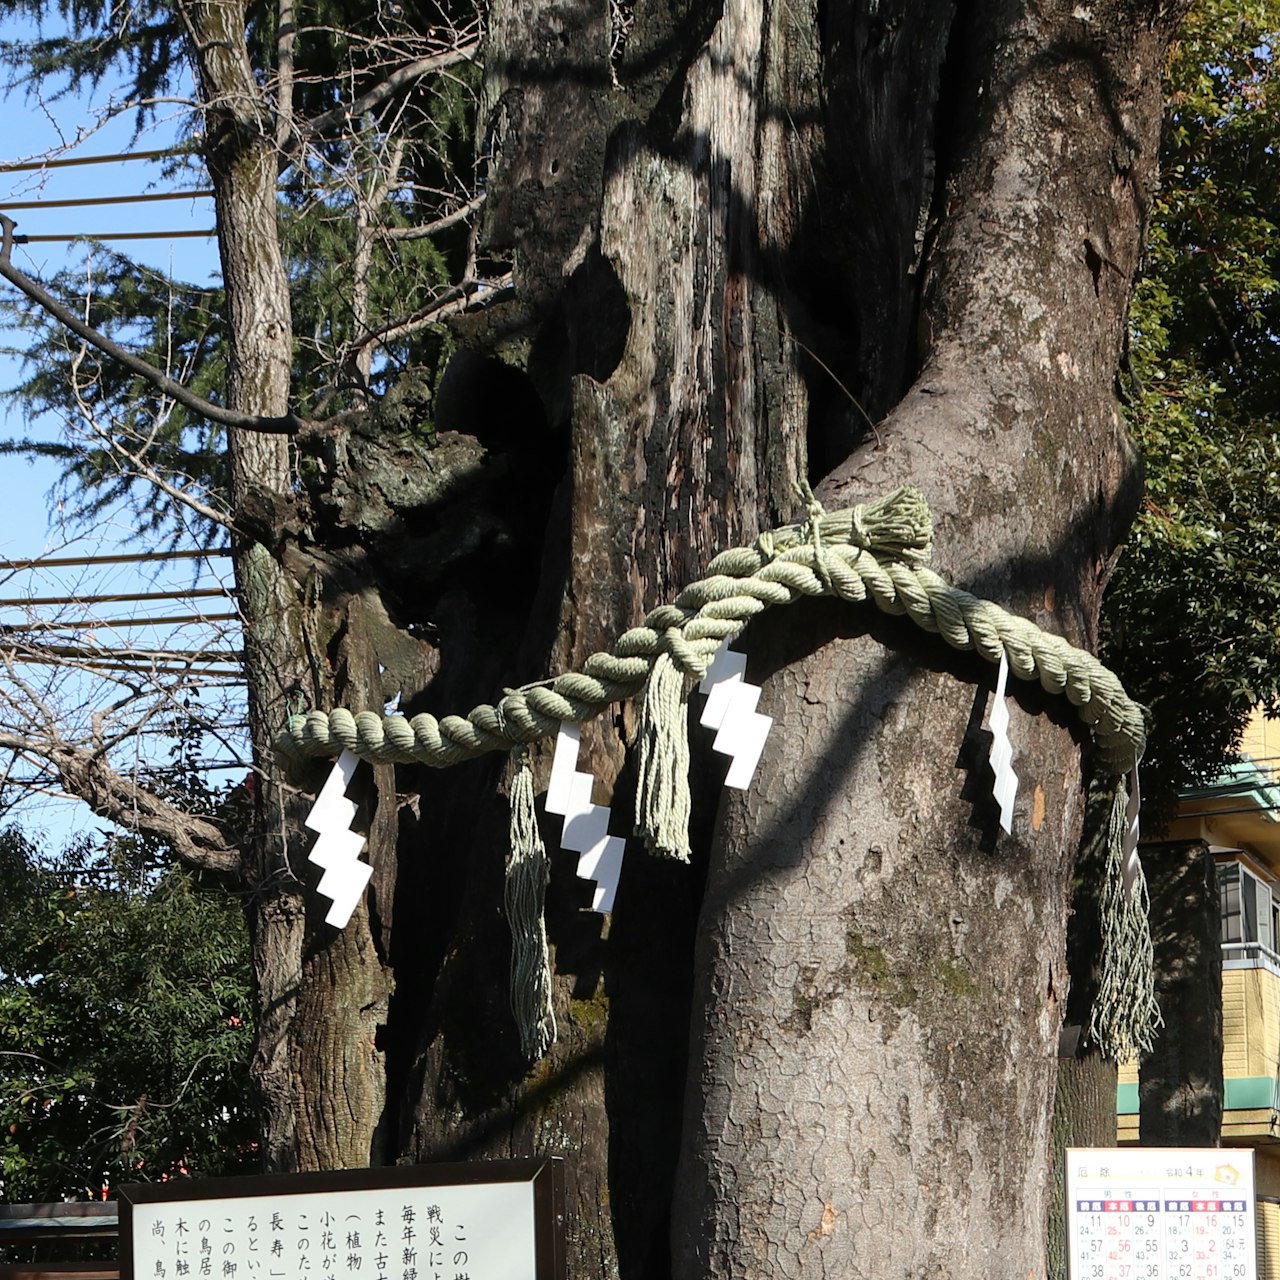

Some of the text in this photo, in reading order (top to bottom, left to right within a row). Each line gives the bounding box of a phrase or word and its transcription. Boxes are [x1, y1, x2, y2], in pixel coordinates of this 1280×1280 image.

[1091, 1214, 1244, 1227] 11 10 9 17 16 15
[1091, 1240, 1103, 1252] 57
[1118, 1240, 1130, 1252] 56
[1146, 1240, 1157, 1252] 55
[1182, 1240, 1188, 1252] 3
[1209, 1240, 1215, 1252] 2
[1092, 1264, 1245, 1277] 38 37 36 62 61 60
